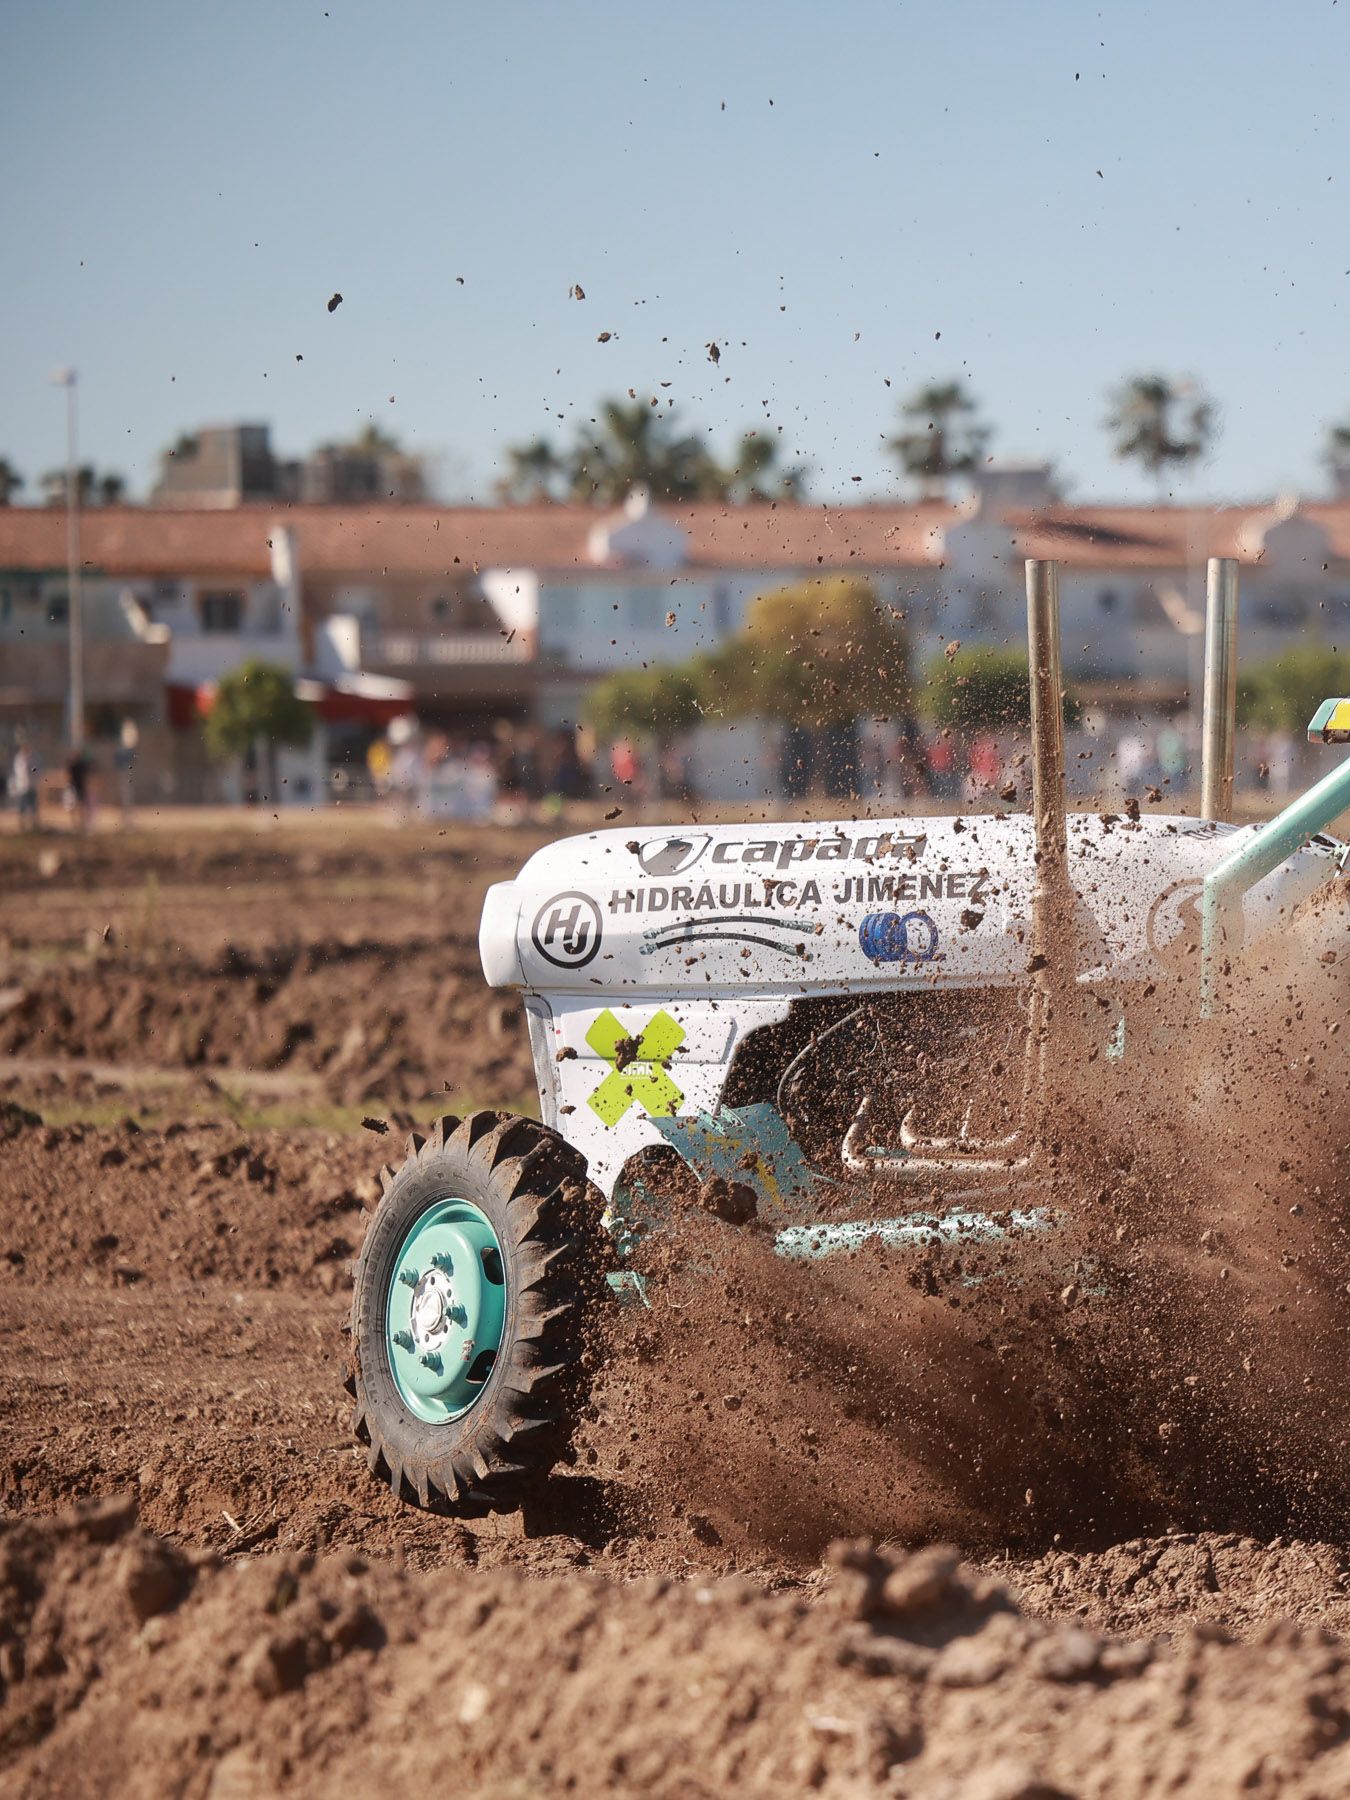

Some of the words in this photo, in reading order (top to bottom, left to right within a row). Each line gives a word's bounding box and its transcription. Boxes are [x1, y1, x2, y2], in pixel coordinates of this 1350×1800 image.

[712, 832, 927, 870] capada
[609, 877, 822, 916] HIDRÁULICA
[834, 872, 991, 904] JIMENEZ
